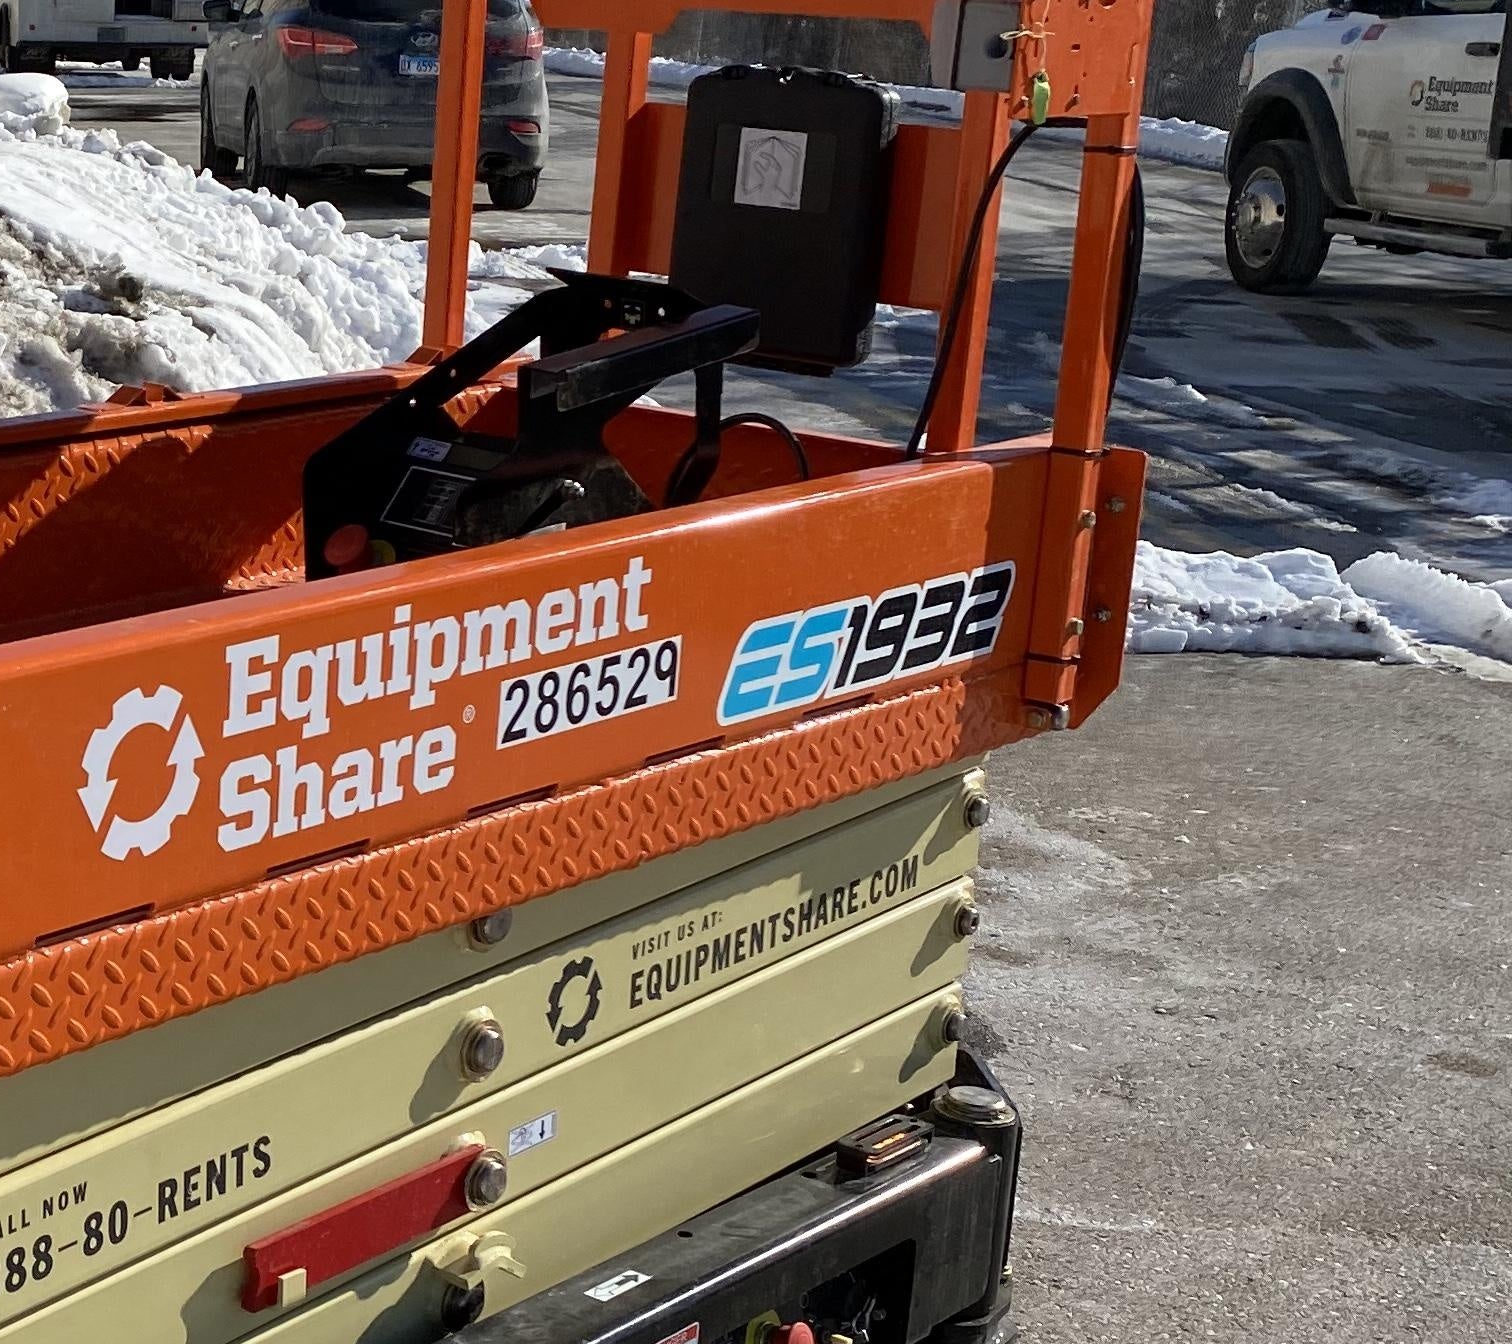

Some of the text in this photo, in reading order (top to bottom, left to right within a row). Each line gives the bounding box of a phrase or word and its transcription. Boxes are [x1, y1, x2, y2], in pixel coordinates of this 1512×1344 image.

[1424, 95, 1459, 113] Share
[1428, 76, 1494, 97] Equipment
[222, 555, 653, 739] Equipment
[500, 639, 678, 745] 286529
[721, 563, 1015, 725] ES1932
[216, 723, 457, 853] Share
[628, 854, 919, 1009] EQUIPMENTSHARE.COM
[631, 910, 723, 960] VISIT US AT:
[42, 1181, 88, 1219] NOW
